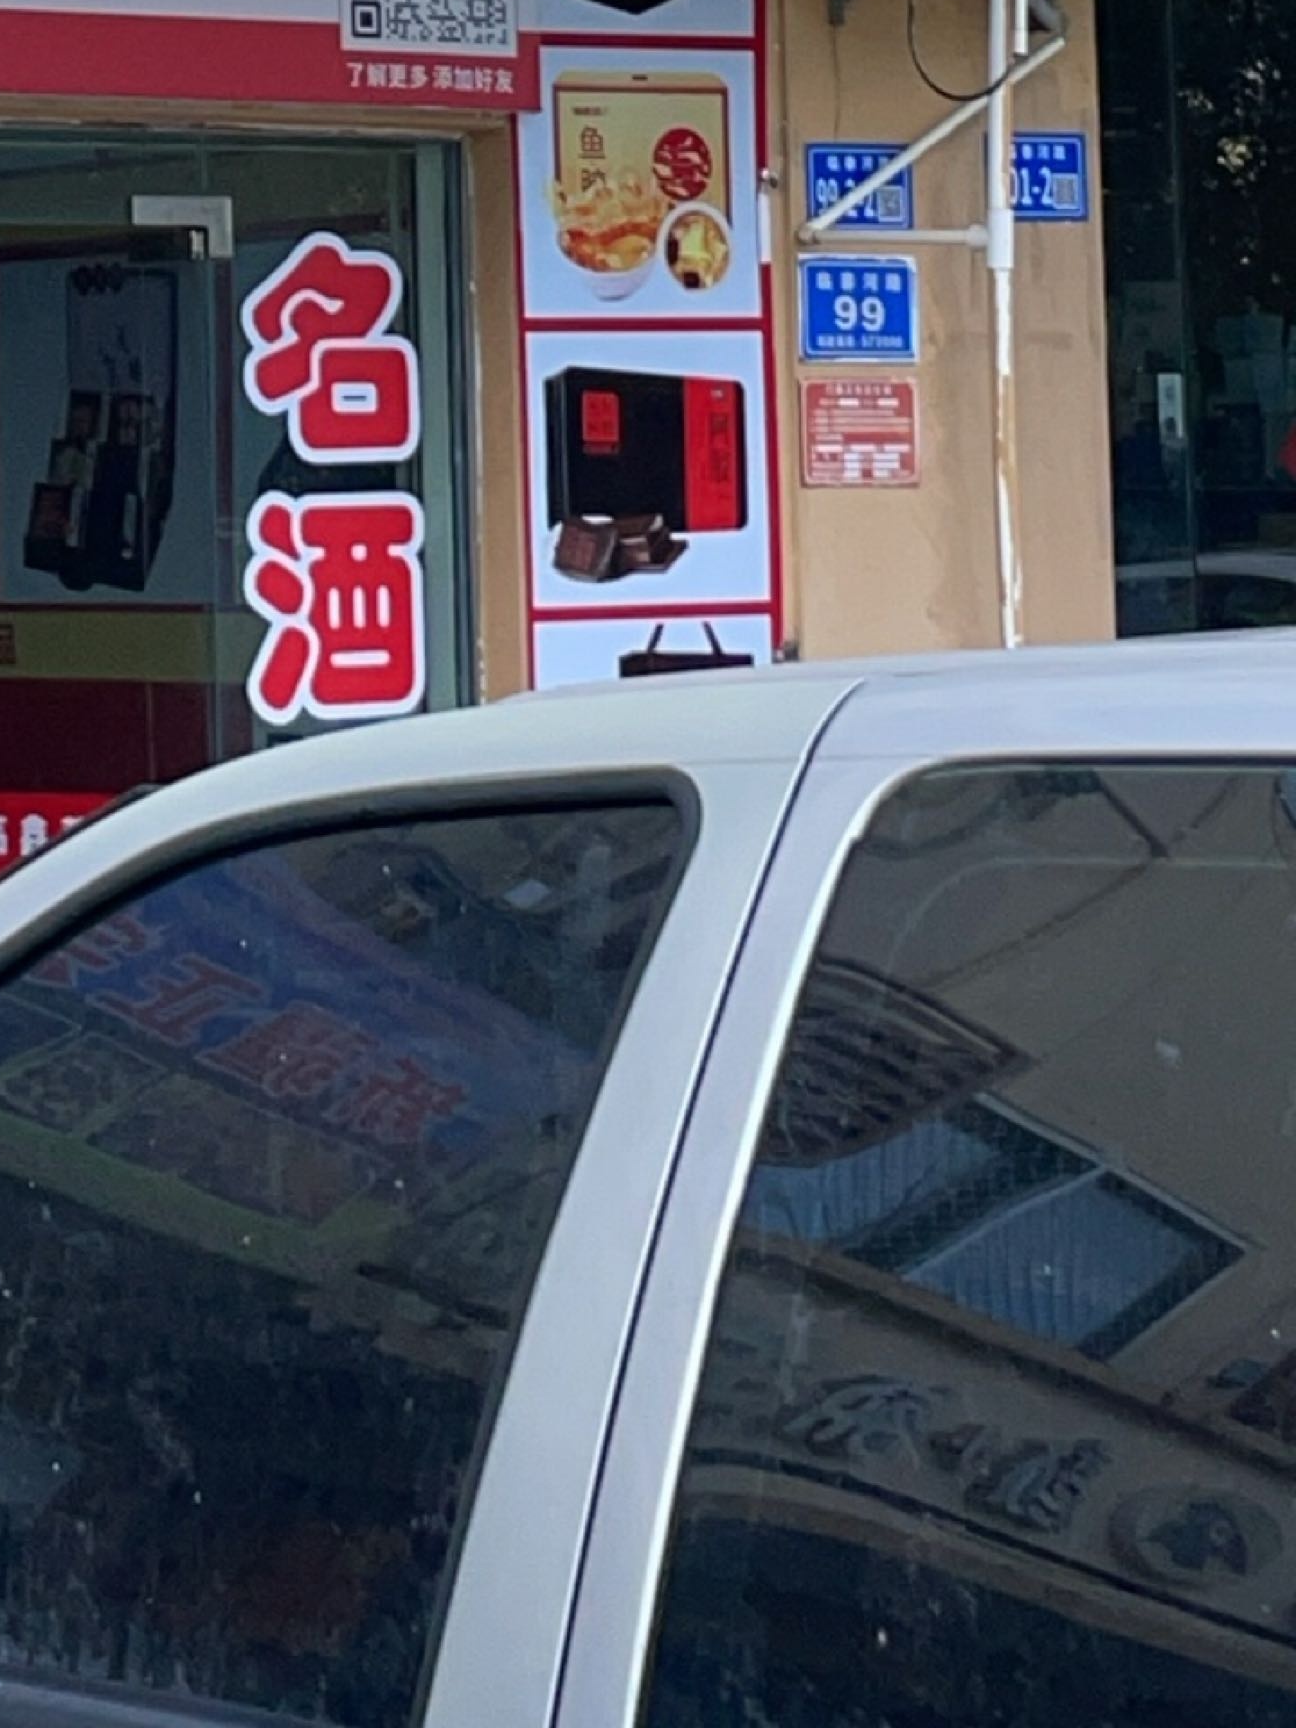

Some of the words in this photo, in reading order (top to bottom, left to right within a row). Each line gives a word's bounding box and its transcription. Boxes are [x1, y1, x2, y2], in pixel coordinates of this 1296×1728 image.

[346, 62, 429, 89] 了解更多
[432, 65, 515, 94] 添加好友
[834, 294, 886, 332] 99
[241, 231, 424, 726] 名酒
